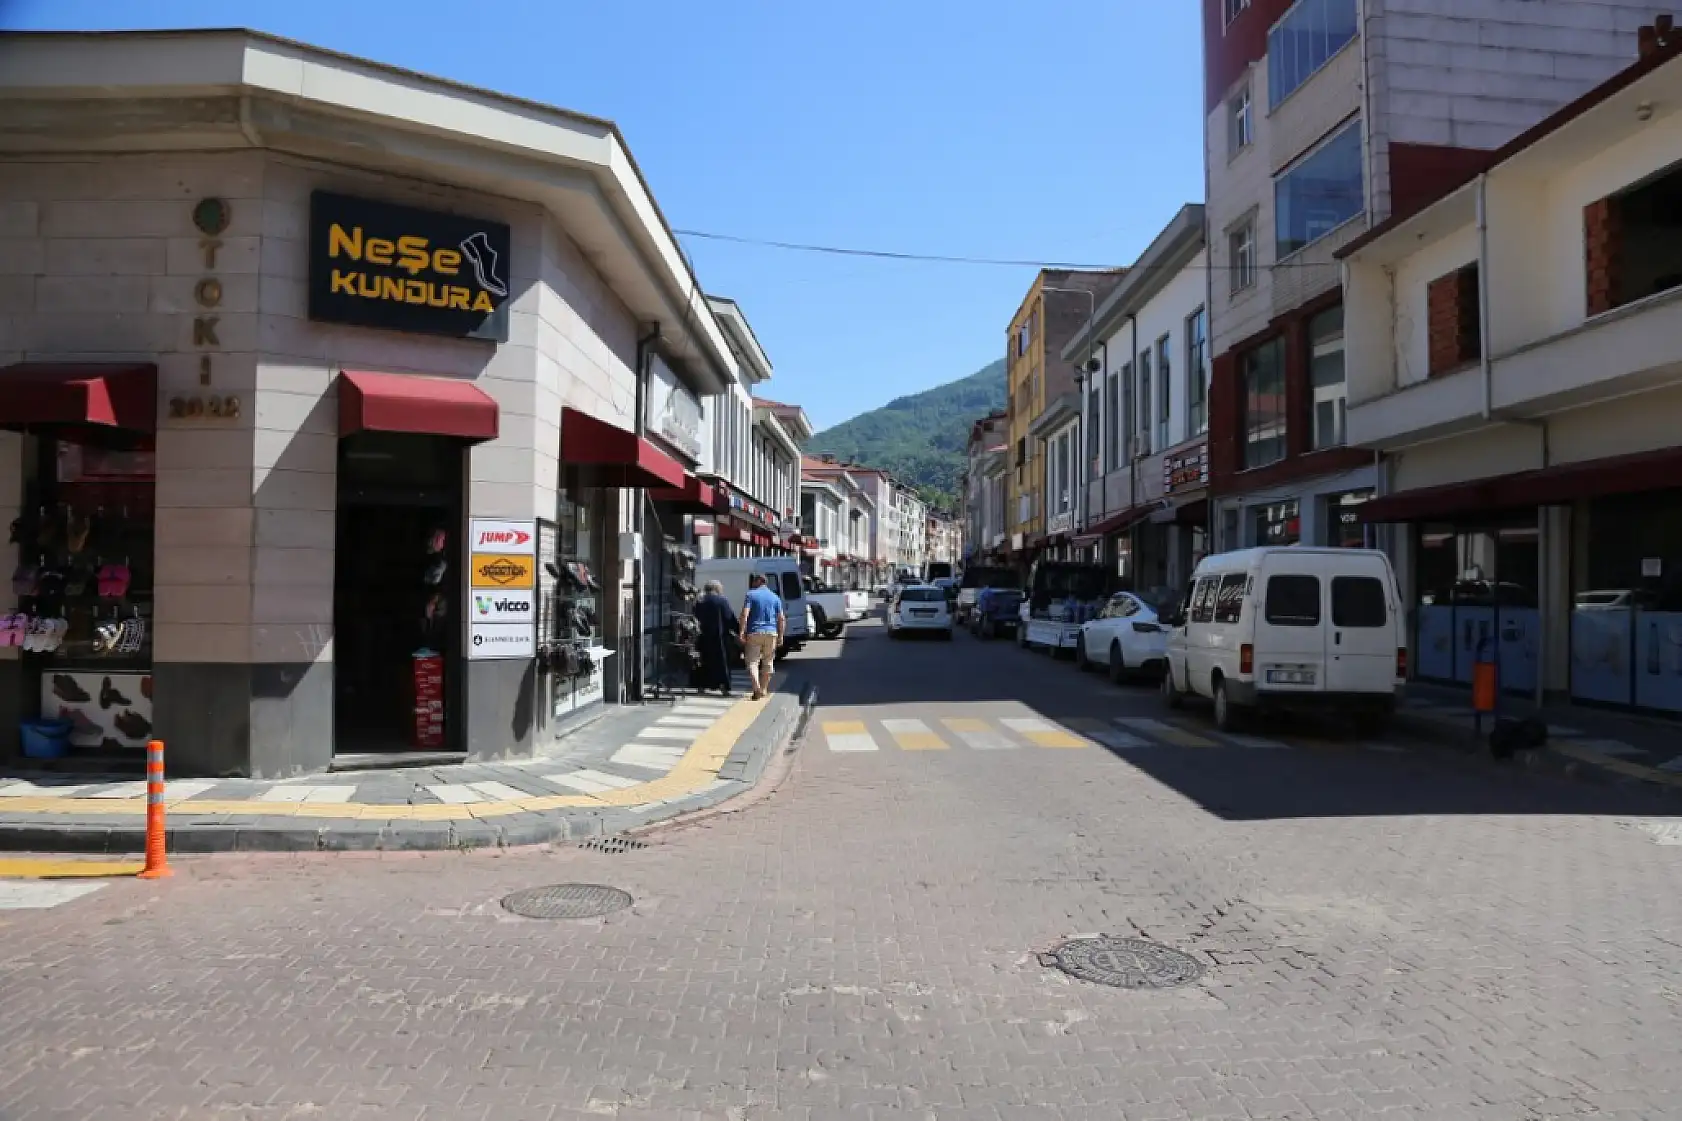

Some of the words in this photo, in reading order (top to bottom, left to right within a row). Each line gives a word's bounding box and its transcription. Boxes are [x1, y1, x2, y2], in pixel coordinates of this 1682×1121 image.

[330, 268, 495, 313] KUNDURA
[479, 531, 514, 545] JUMP
[494, 597, 530, 612] vicco
